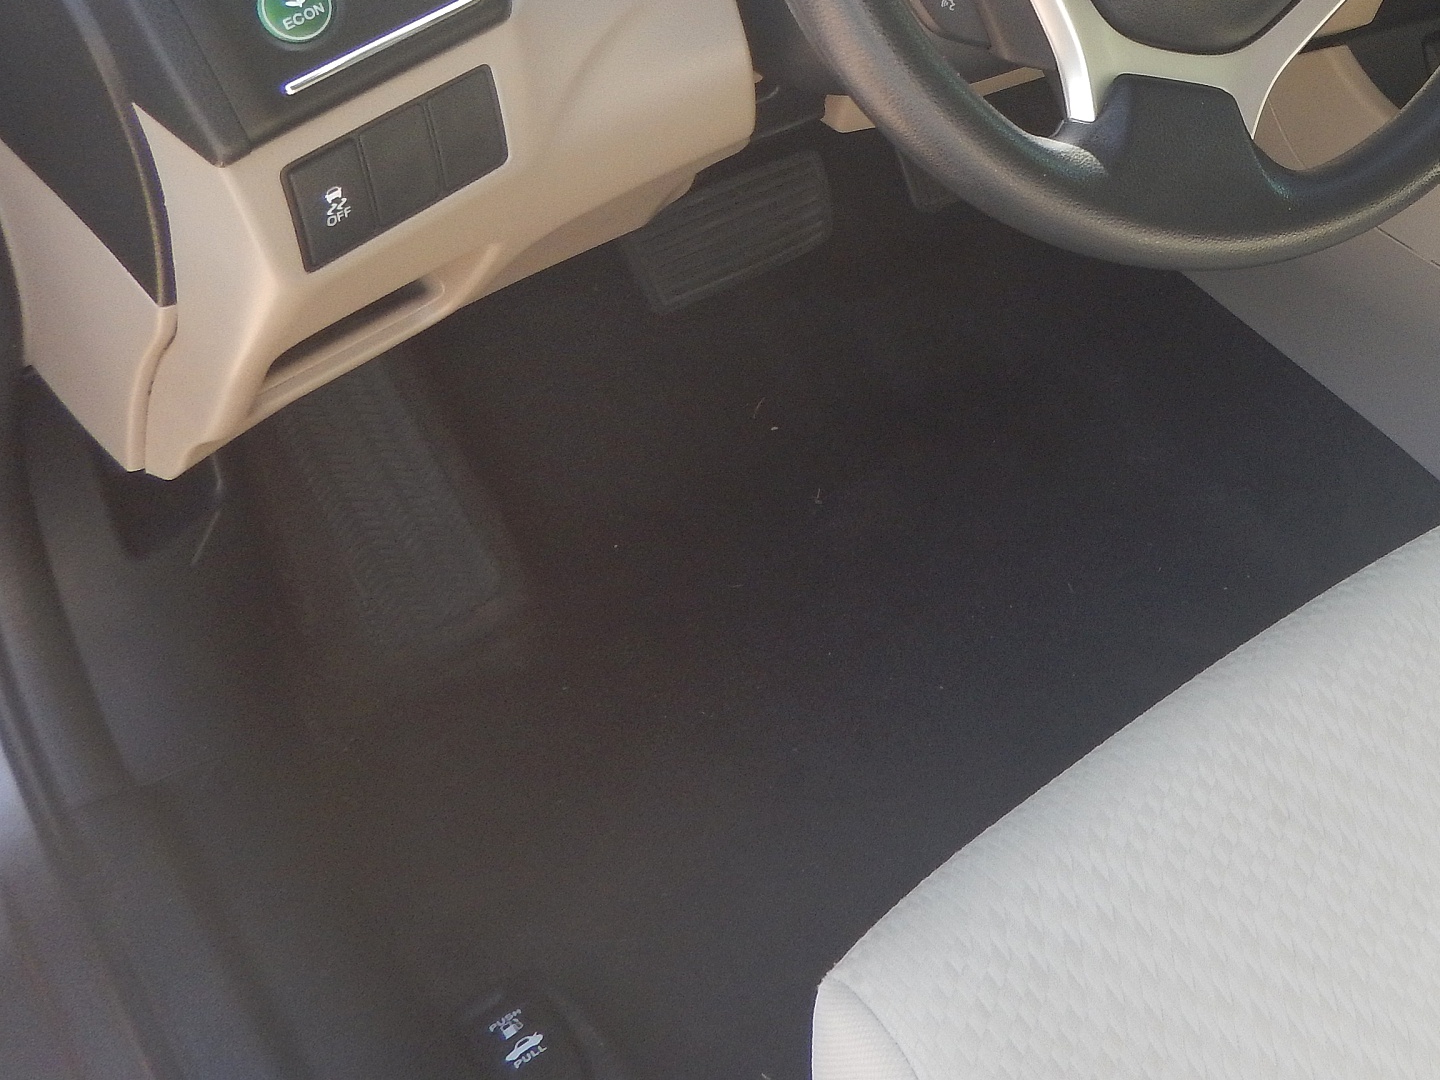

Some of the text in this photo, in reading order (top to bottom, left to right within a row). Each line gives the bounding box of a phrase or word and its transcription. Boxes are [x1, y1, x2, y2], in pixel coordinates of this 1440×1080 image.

[282, 2, 325, 31] ECON
[326, 206, 352, 228] OFF
[488, 1008, 522, 1033] PUSH
[513, 1044, 548, 1069] PULL
